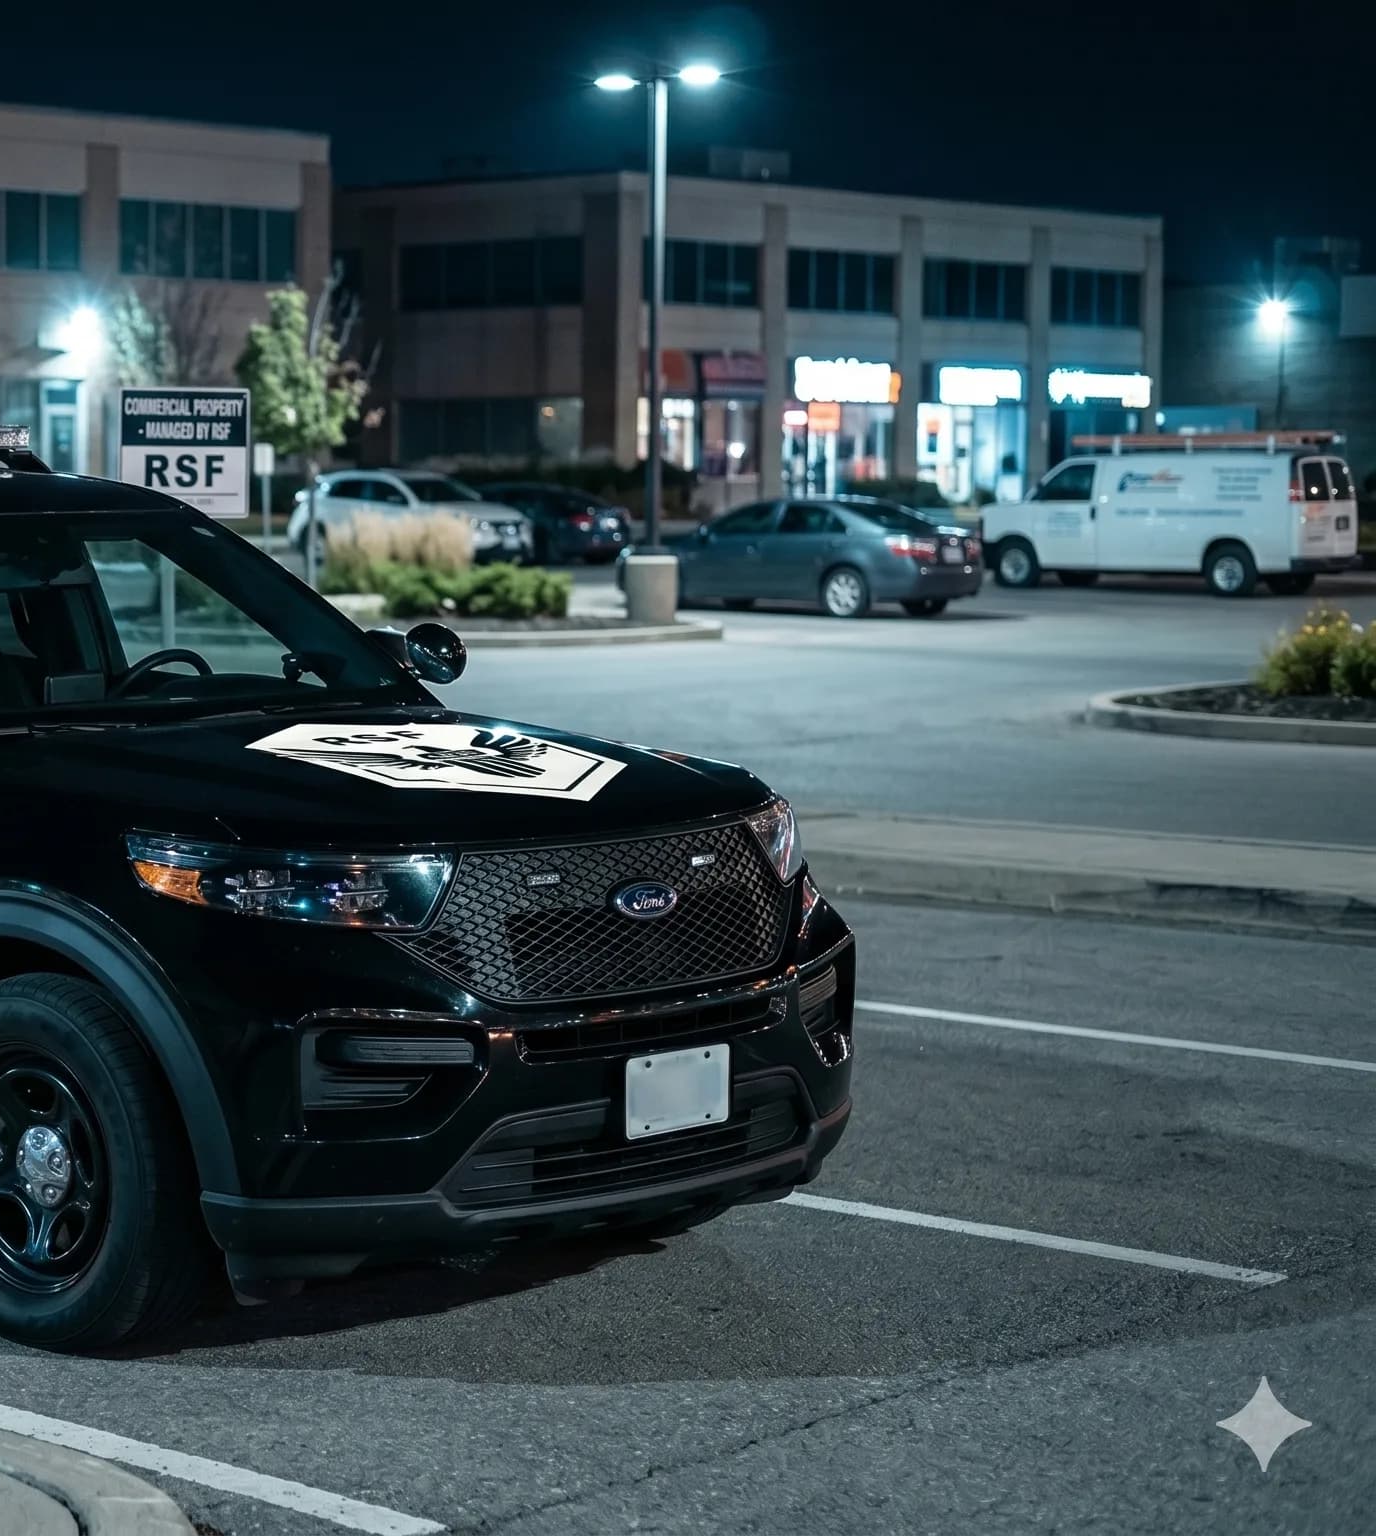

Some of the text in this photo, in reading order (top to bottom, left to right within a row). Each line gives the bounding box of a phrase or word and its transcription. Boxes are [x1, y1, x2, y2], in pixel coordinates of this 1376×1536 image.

[125, 398, 244, 417] COMMERCIAL PROPERTY
[146, 421, 195, 439] MANAGED
[196, 422, 210, 440] BY
[212, 422, 232, 440] RSF
[144, 454, 225, 488] RSF
[312, 730, 424, 746] RSF
